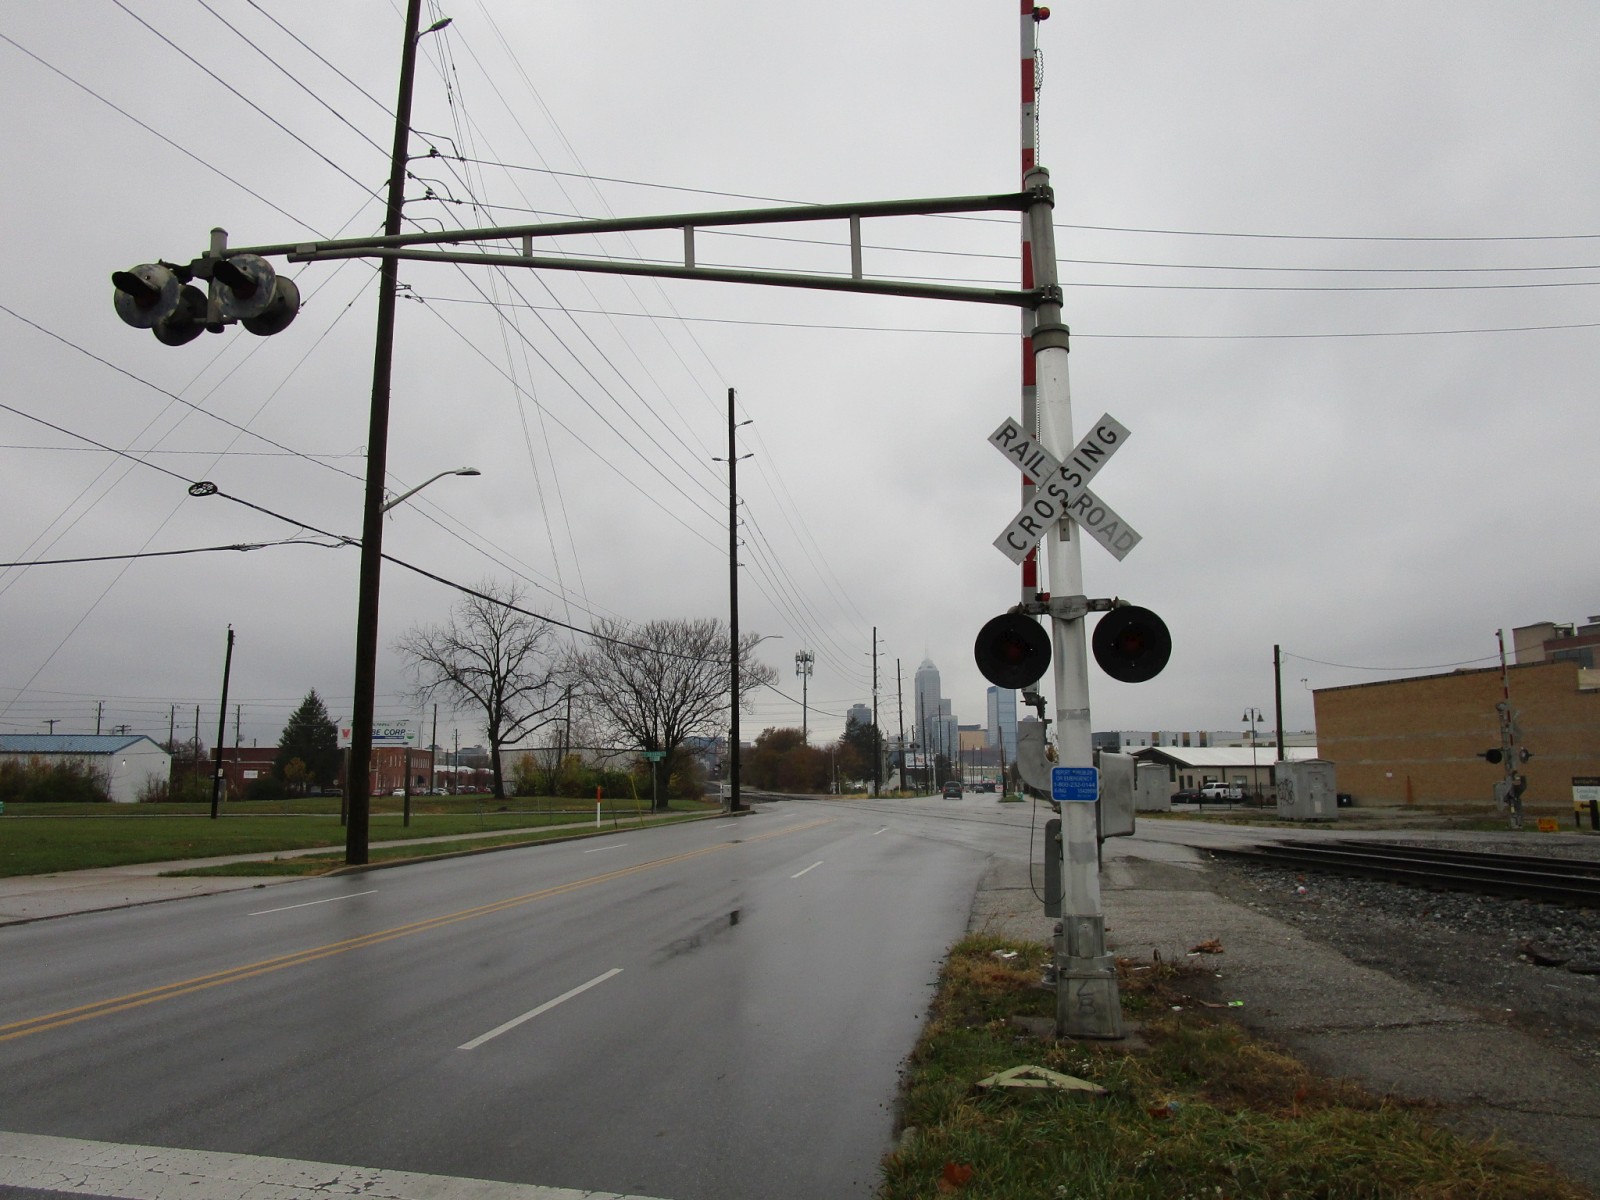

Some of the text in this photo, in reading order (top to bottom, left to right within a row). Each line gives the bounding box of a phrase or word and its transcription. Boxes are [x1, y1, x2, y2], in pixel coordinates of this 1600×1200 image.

[996, 425, 1134, 552] RAIL ROAD
[1006, 426, 1117, 551] CROSSING
